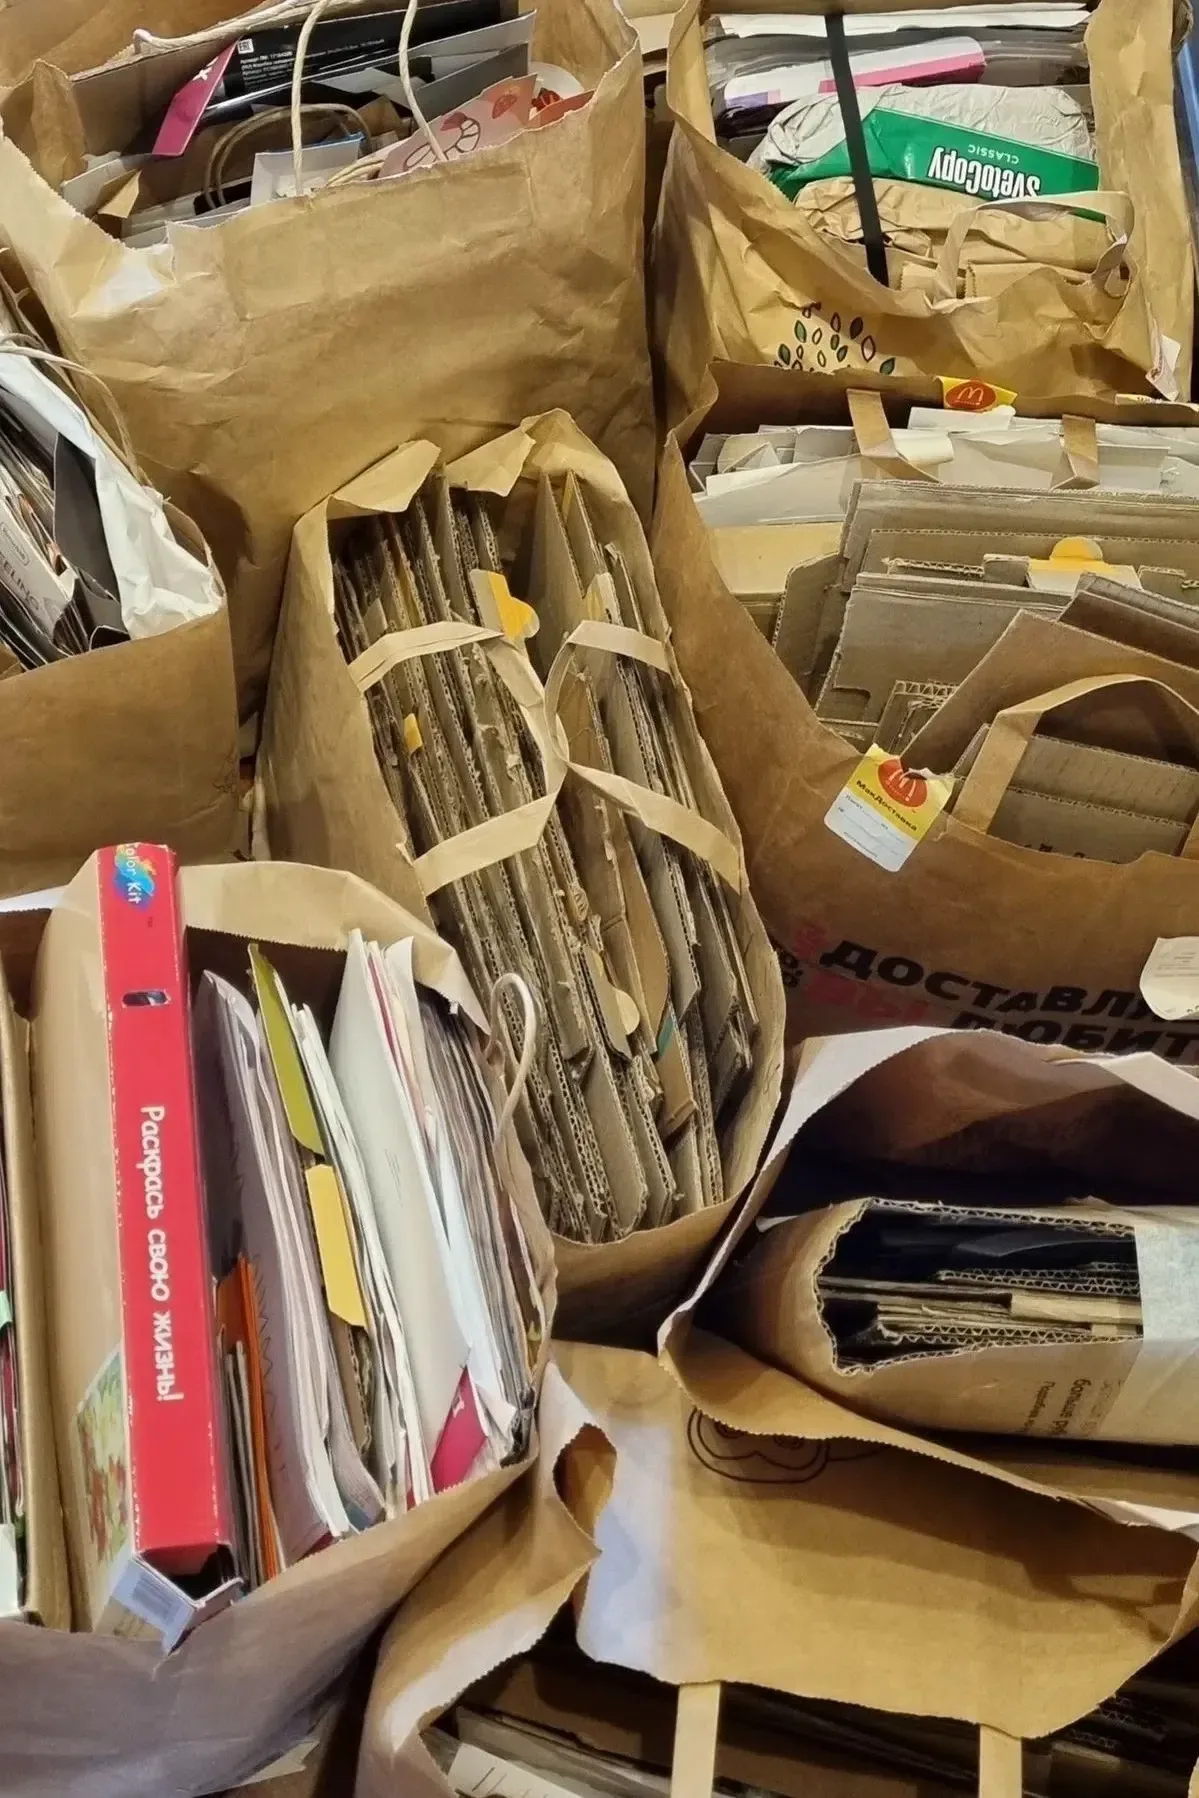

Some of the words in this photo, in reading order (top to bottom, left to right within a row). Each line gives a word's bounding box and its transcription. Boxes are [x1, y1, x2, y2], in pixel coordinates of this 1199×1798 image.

[927, 146, 1041, 199] SvetoCopy
[967, 143, 1020, 165] CLASSIC
[126, 882, 143, 904] Kit
[135, 1105, 165, 1220] Раскрась
[147, 1228, 170, 1301] свою
[152, 1310, 185, 1402] жизнь!
